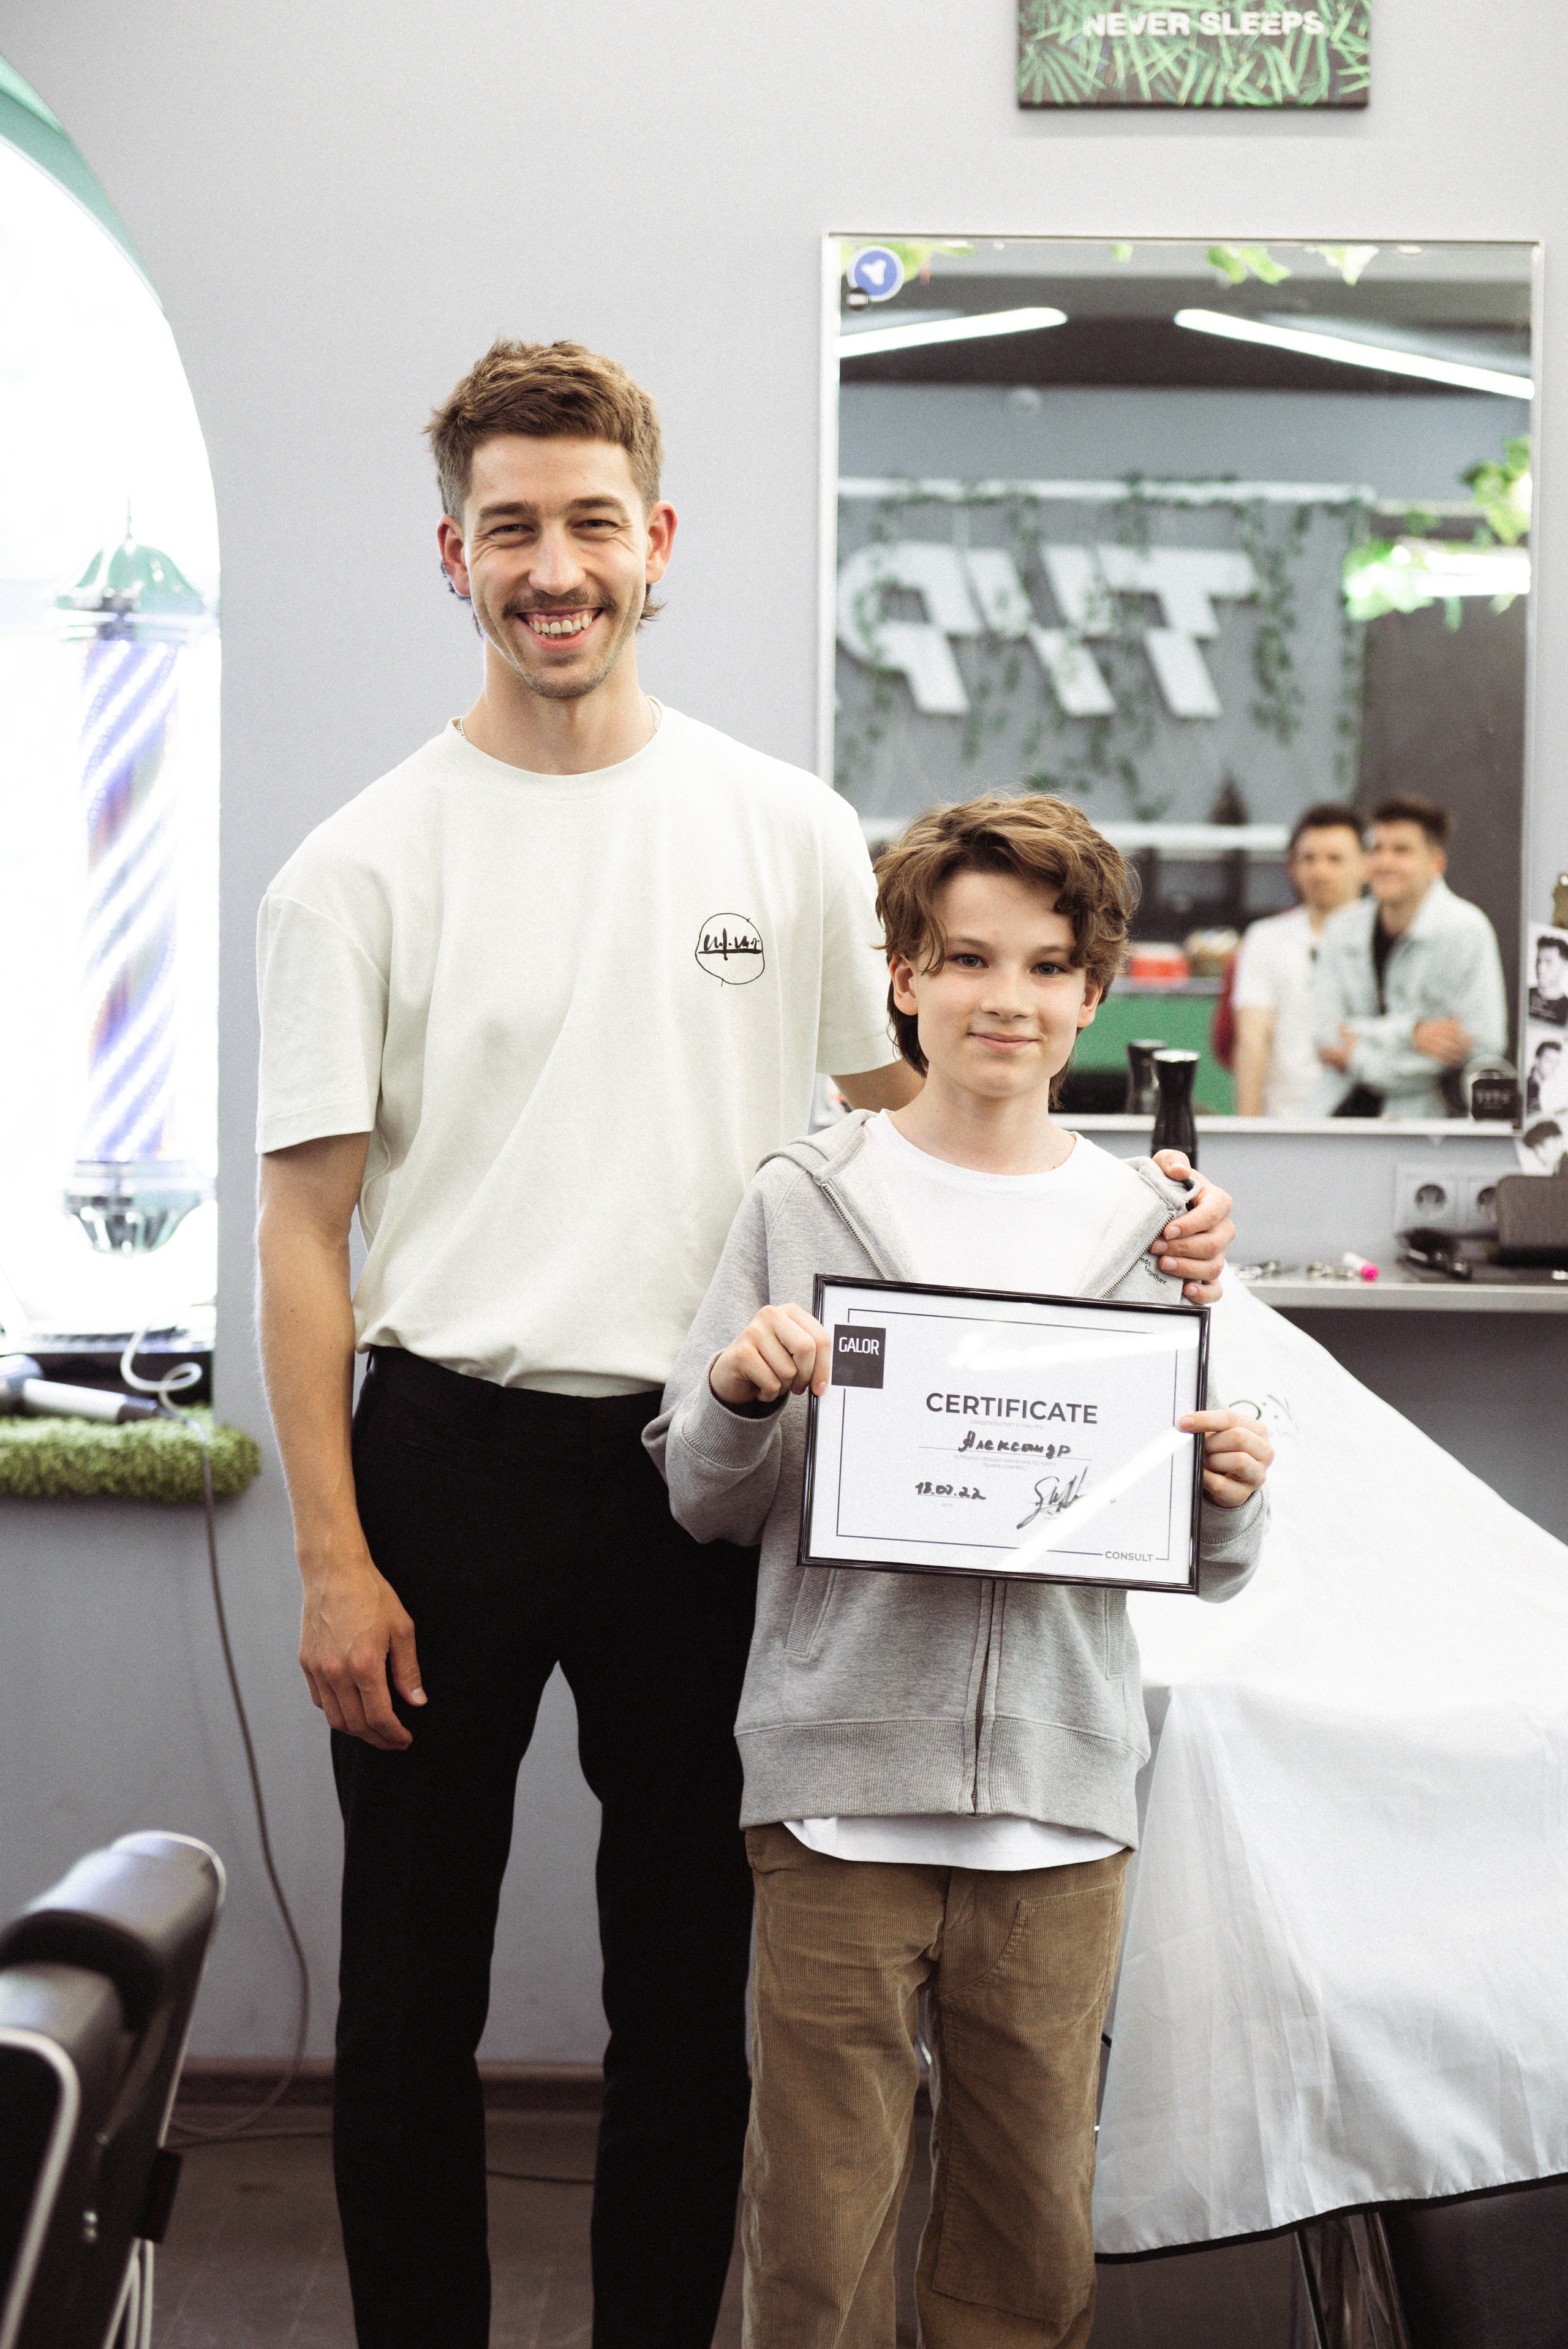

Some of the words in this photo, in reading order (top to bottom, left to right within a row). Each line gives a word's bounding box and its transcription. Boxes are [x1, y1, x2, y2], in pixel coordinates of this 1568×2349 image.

[1082, 11, 1191, 37] NEVER
[1199, 10, 1325, 36] SLEEPS
[1145, 1265, 1167, 1284] together
[839, 1337, 880, 1355] GALOR
[926, 1392, 1098, 1425] CERTIFICATE
[1105, 1551, 1153, 1562] CONSULT
